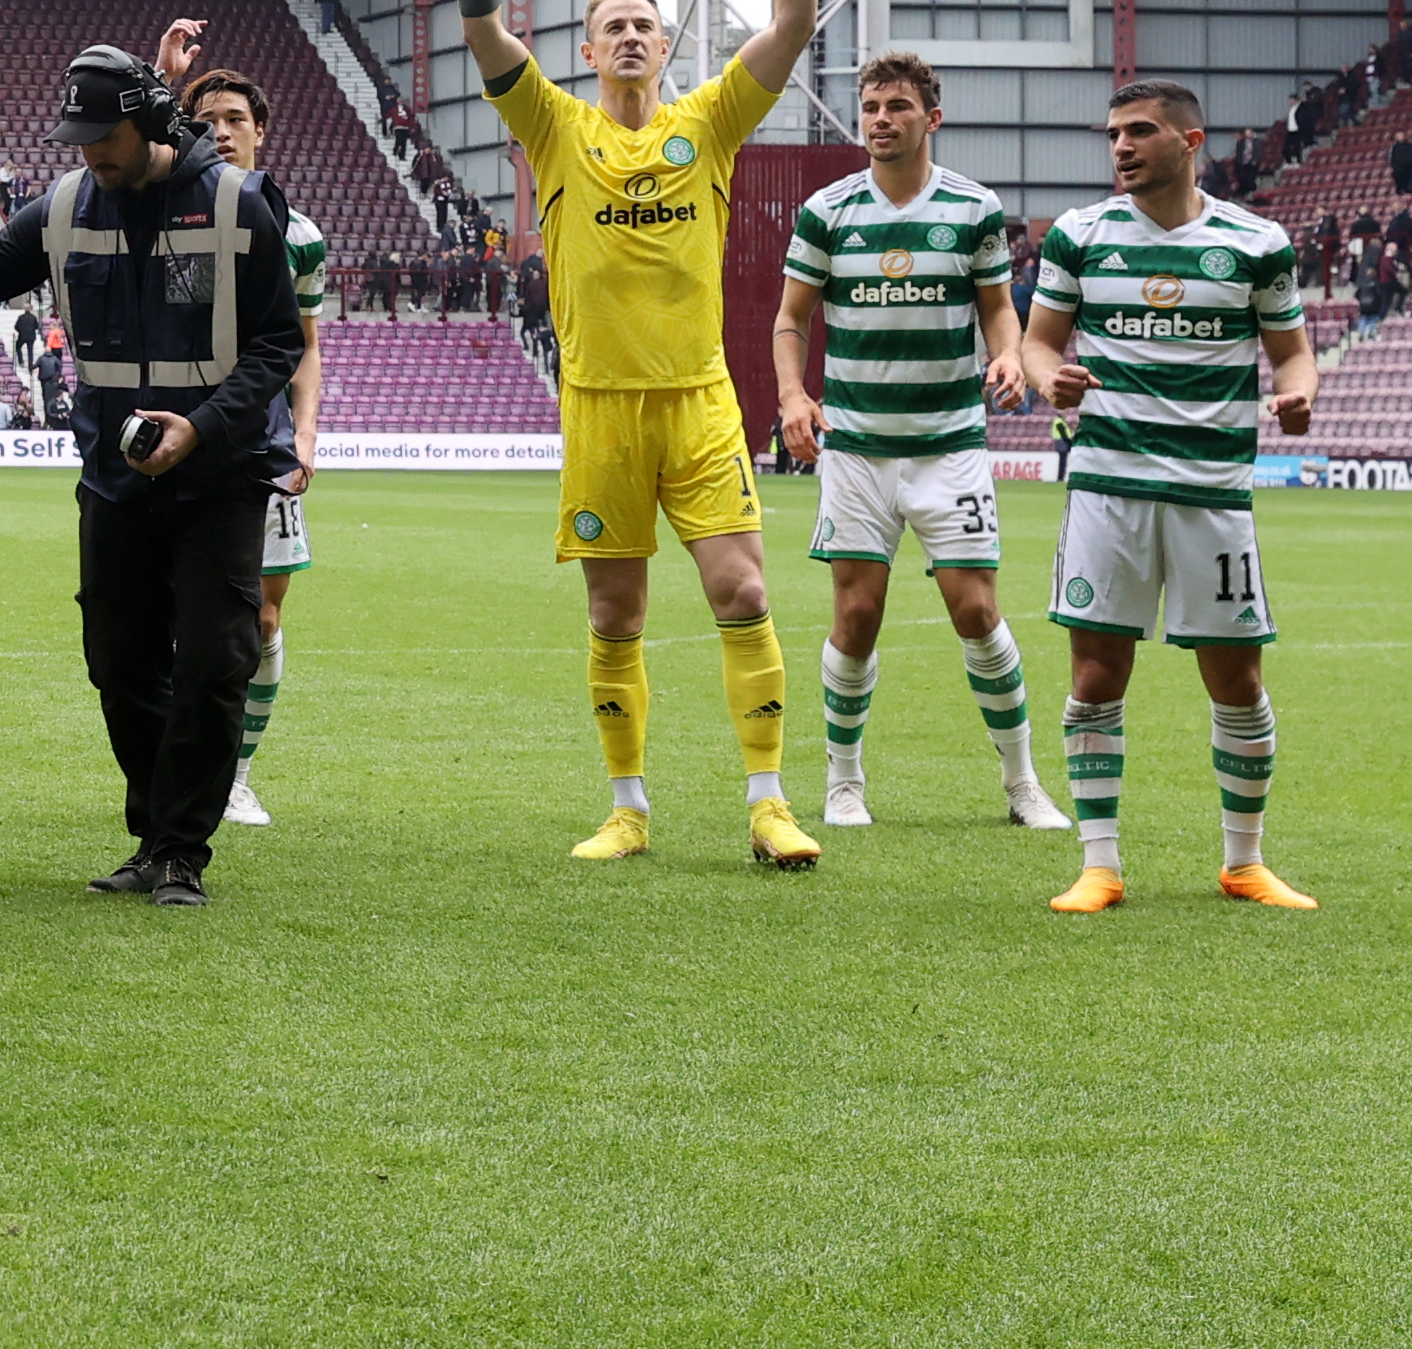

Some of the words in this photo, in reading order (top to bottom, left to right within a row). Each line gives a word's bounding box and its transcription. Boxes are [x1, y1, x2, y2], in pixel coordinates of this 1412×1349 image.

[183, 214, 207, 223] sports
[595, 201, 698, 229] dafabet
[850, 281, 947, 306] dafabet
[1105, 311, 1223, 339] dafabet
[13, 437, 66, 458] Self
[365, 443, 420, 458] media
[425, 443, 449, 458] for
[455, 446, 500, 458] more
[505, 443, 564, 459] details
[992, 460, 1044, 481] ARAGE
[1328, 459, 1412, 491] FOOTA
[275, 500, 299, 539] 18
[956, 495, 997, 533] 33
[1215, 551, 1256, 602] 11
